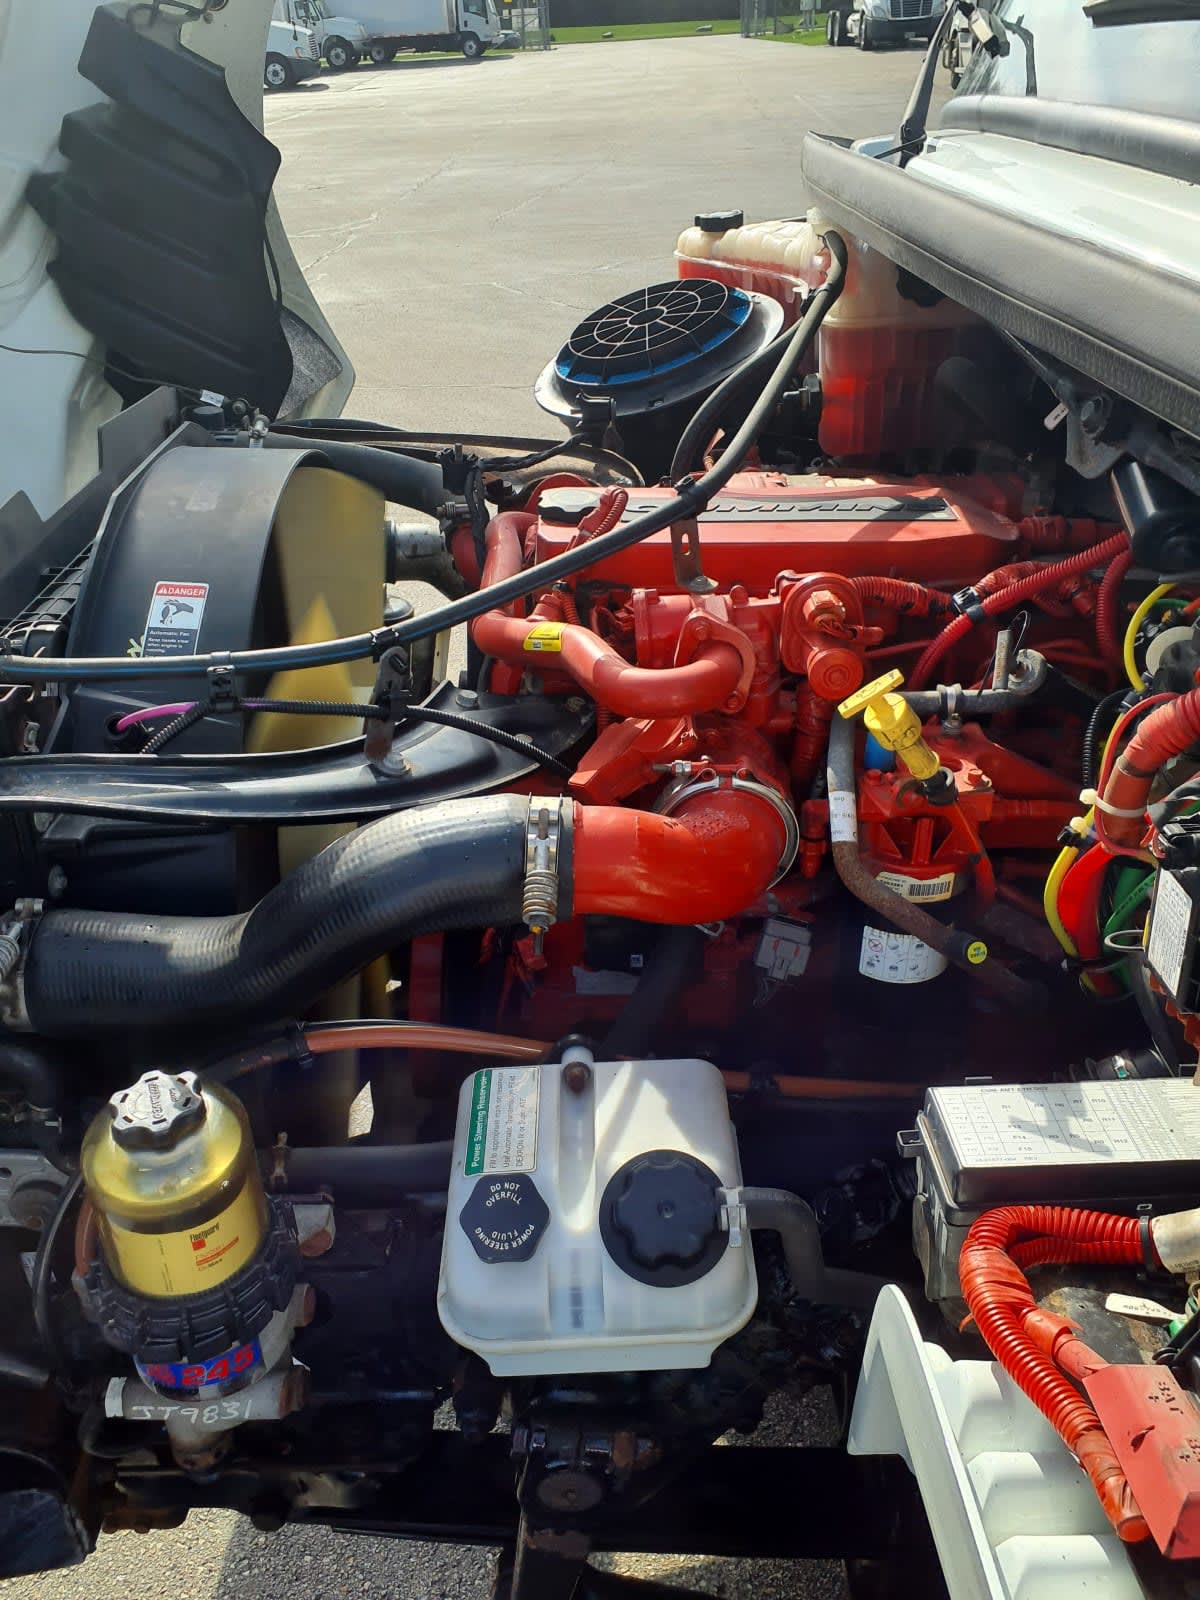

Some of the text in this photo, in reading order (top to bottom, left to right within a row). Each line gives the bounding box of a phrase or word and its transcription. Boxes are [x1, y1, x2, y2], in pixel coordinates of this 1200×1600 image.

[168, 587, 205, 596] DANGER
[471, 1076, 488, 1168] Power Steering Reservoir
[490, 1181, 521, 1193] DO NOT
[485, 1191, 523, 1207] OVERFILL
[475, 1223, 535, 1250] POWER STEERING
[491, 1229, 519, 1241] FLUID
[182, 1342, 256, 1386] 245
